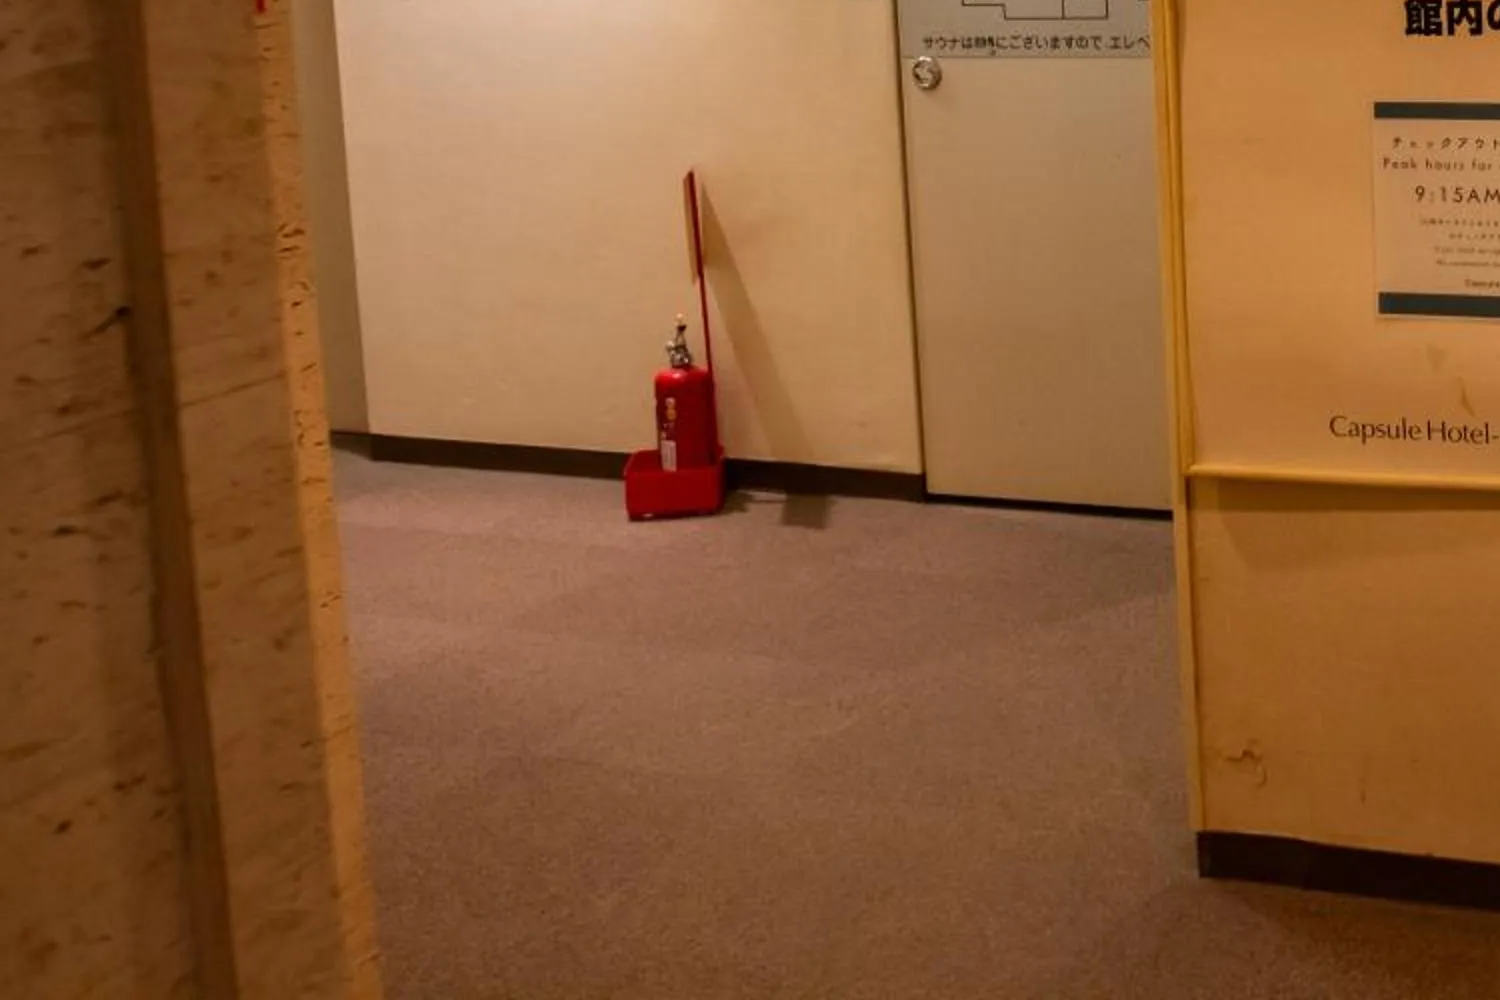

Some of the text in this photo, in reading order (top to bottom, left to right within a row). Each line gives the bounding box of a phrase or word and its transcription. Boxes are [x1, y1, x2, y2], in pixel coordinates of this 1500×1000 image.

[1383, 157, 1418, 171] Peak
[1425, 158, 1465, 171] hours
[1471, 158, 1494, 172] for
[1329, 414, 1423, 444] Capsule
